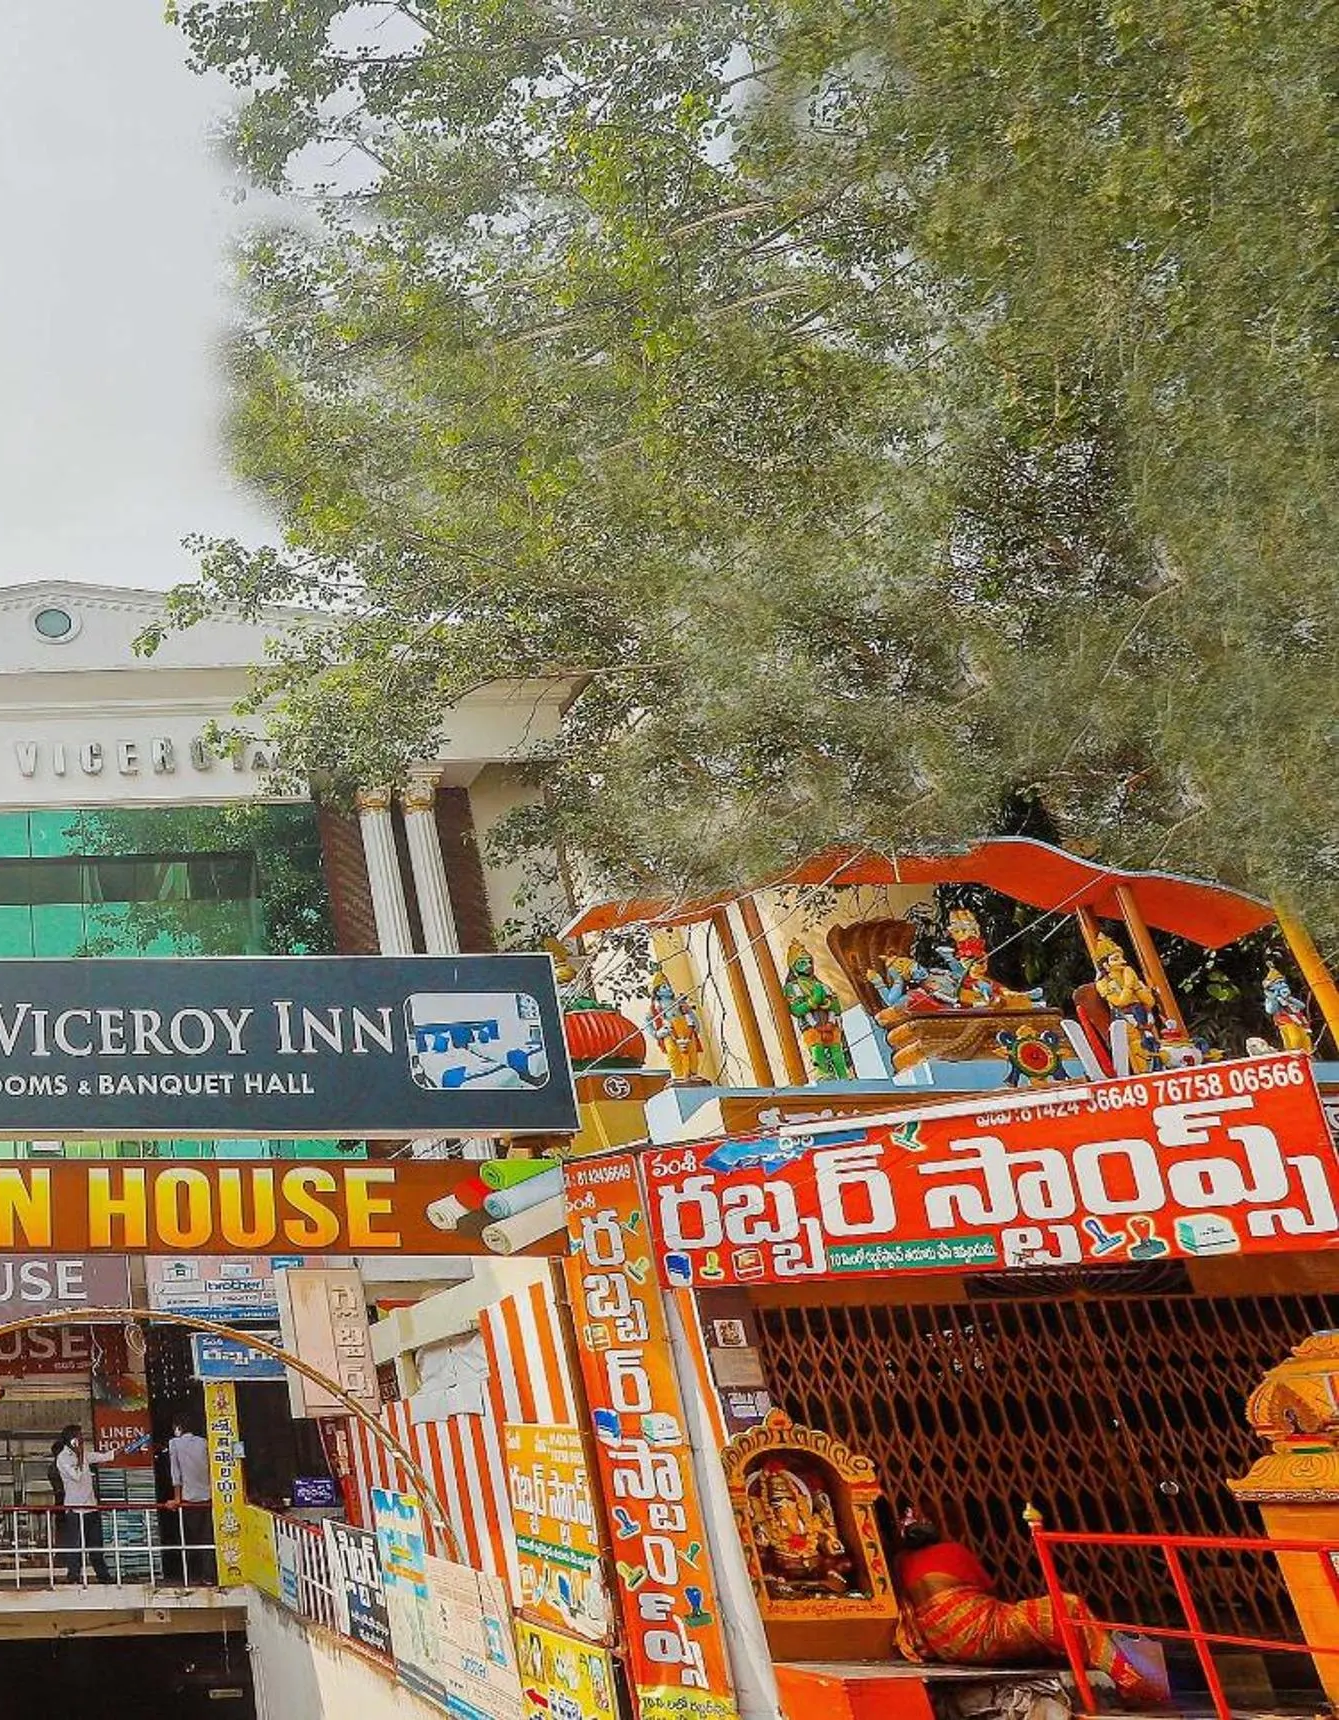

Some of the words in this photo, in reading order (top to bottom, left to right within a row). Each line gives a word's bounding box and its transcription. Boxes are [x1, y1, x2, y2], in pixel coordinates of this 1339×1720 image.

[272, 1001, 393, 1054] INN
[77, 1080, 92, 1096] &
[98, 1073, 234, 1097] BANQUET
[243, 1073, 315, 1094] HALL
[1156, 1072, 1224, 1103] 76758
[1228, 1060, 1305, 1093] 06566
[89, 1167, 402, 1248] HOUSE
[657, 1143, 898, 1278] రబ్బర్
[208, 1280, 262, 1291] brother
[100, 1426, 146, 1439] LINEN
